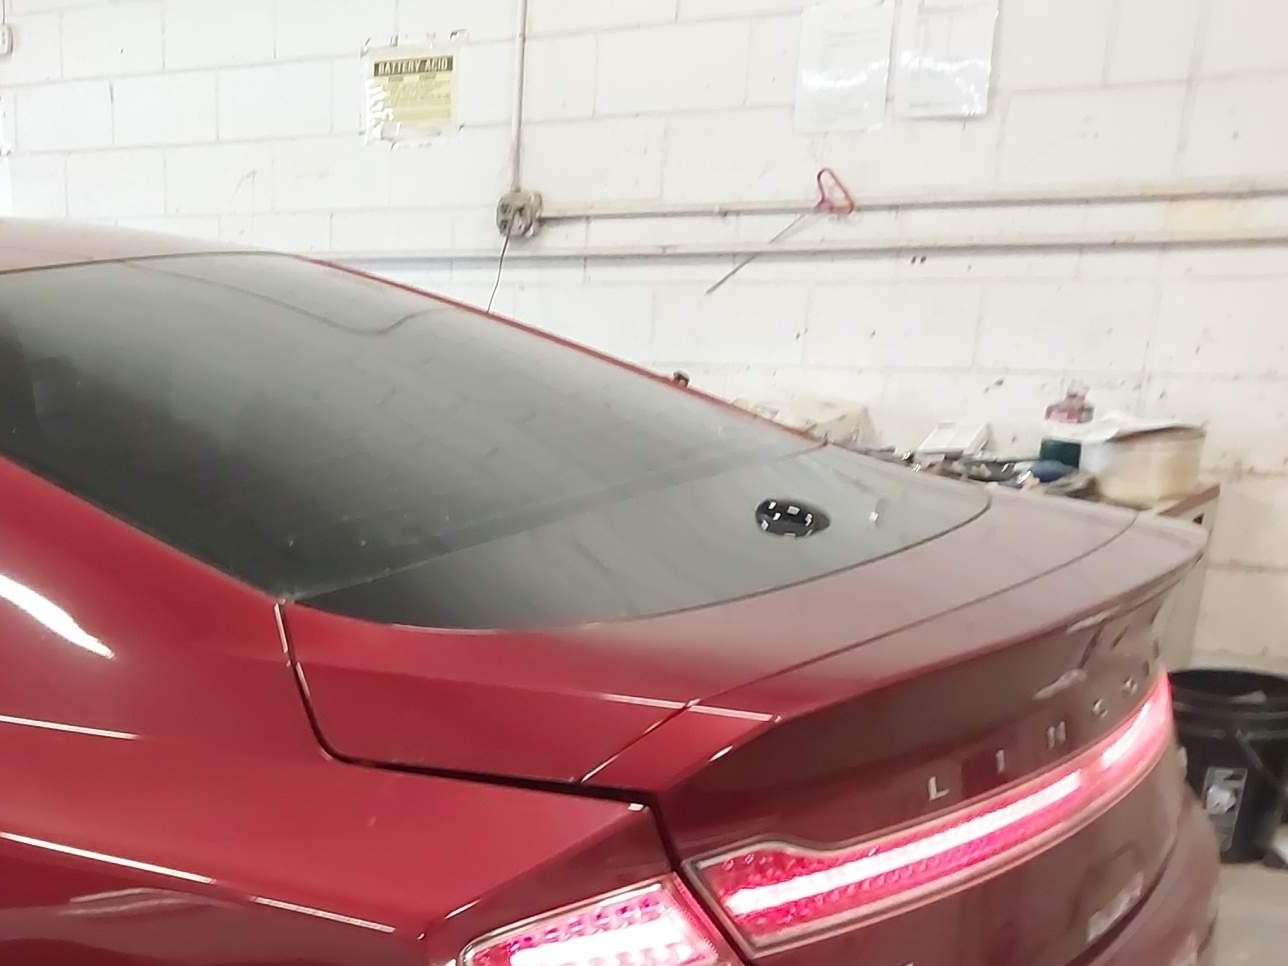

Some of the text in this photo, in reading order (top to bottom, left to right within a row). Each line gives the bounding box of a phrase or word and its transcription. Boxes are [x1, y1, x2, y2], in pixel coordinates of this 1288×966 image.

[378, 57, 448, 75] BATTERY ACID
[927, 637, 1160, 801] LINCO
